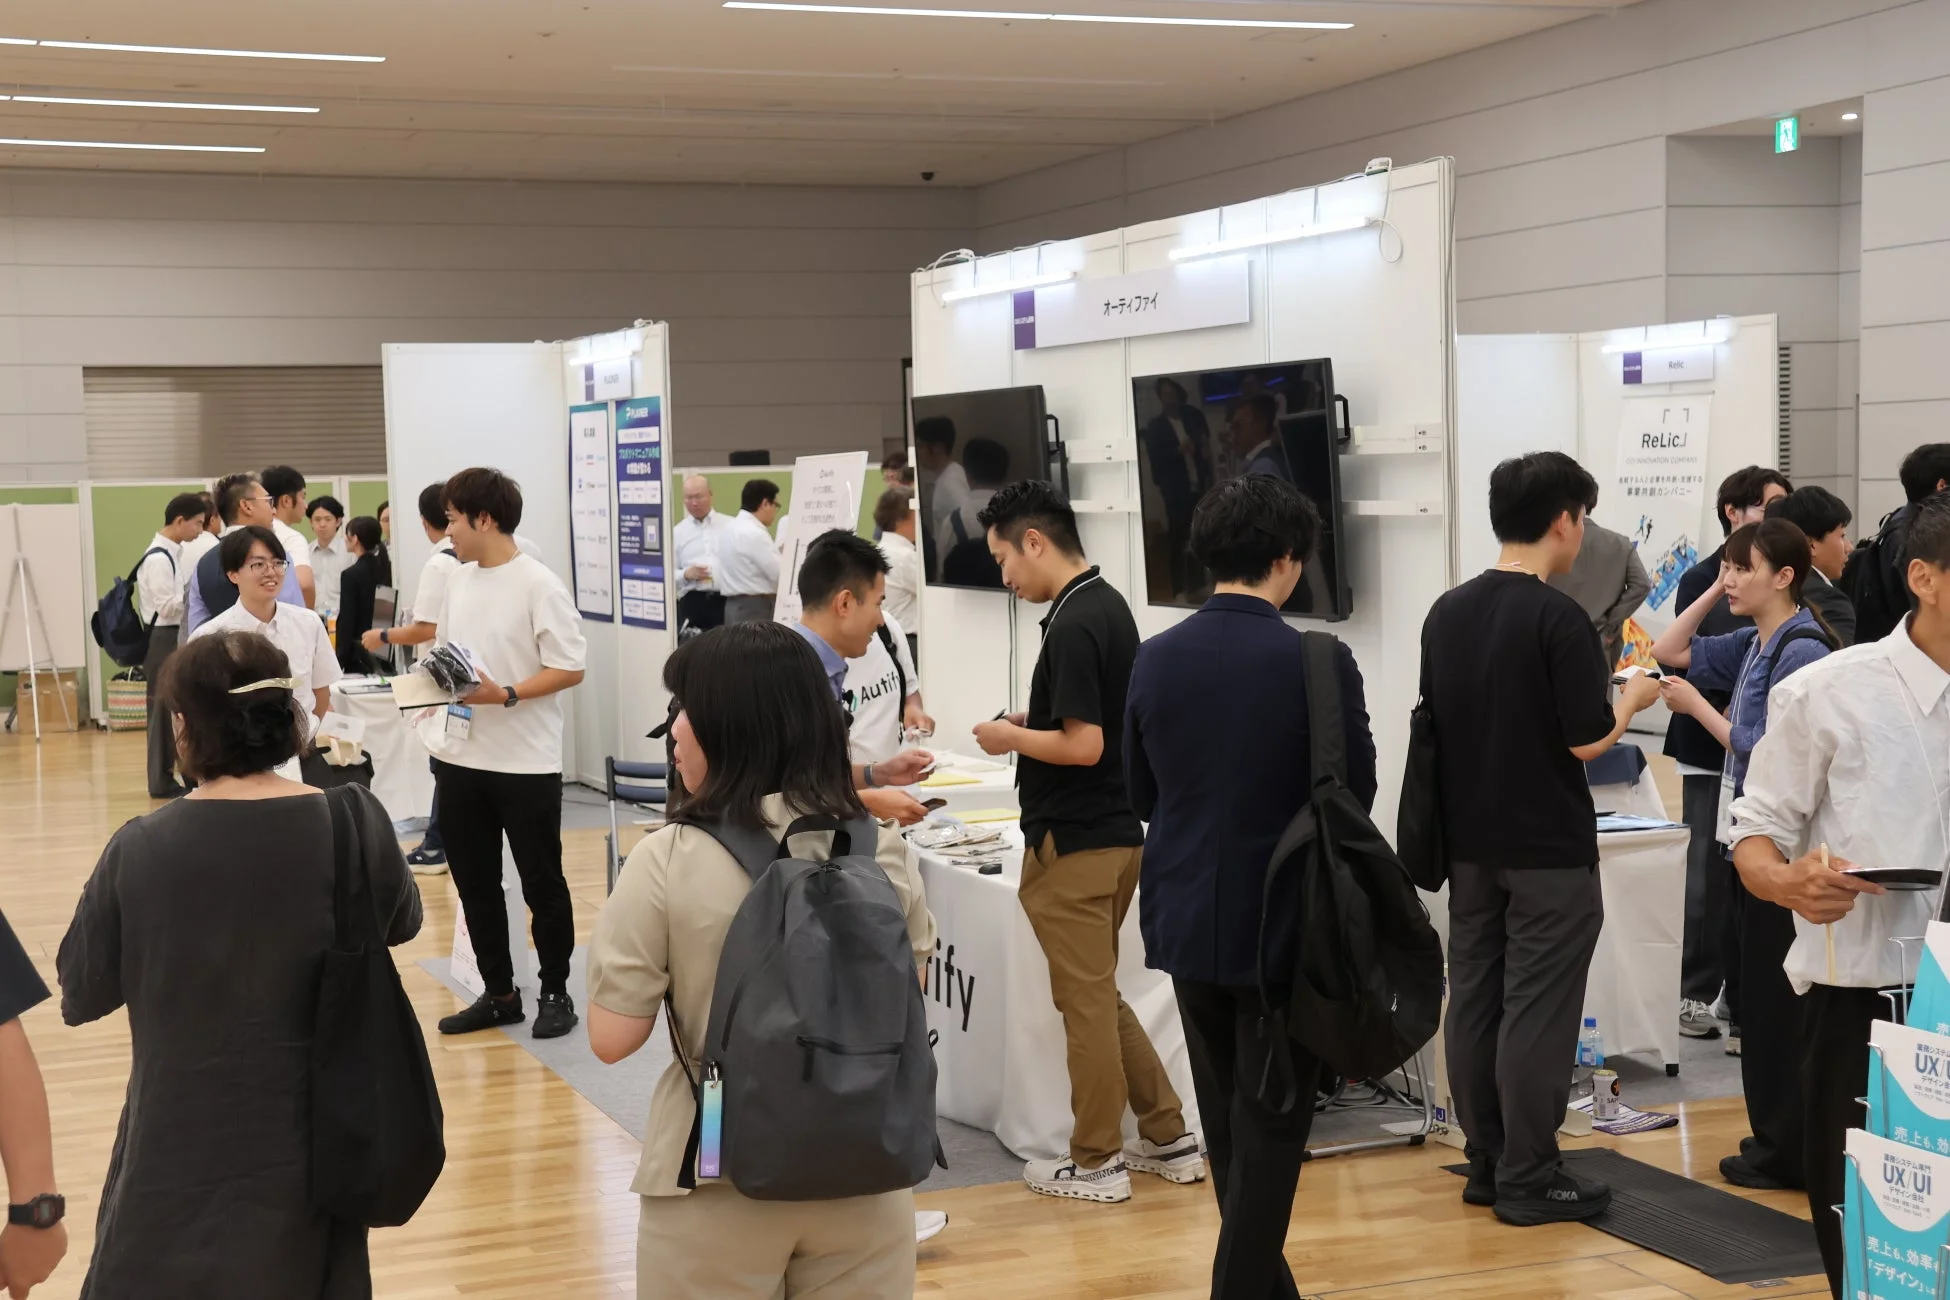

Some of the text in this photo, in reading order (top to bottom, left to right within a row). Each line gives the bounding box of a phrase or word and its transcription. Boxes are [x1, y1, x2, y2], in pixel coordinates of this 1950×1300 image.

[1104, 292, 1159, 316] オーティファイ
[1668, 360, 1684, 369] Relic
[861, 671, 901, 704] Autif
[1883, 1162, 1931, 1196] UX/UI
[1546, 1188, 1578, 1201] HOKA
